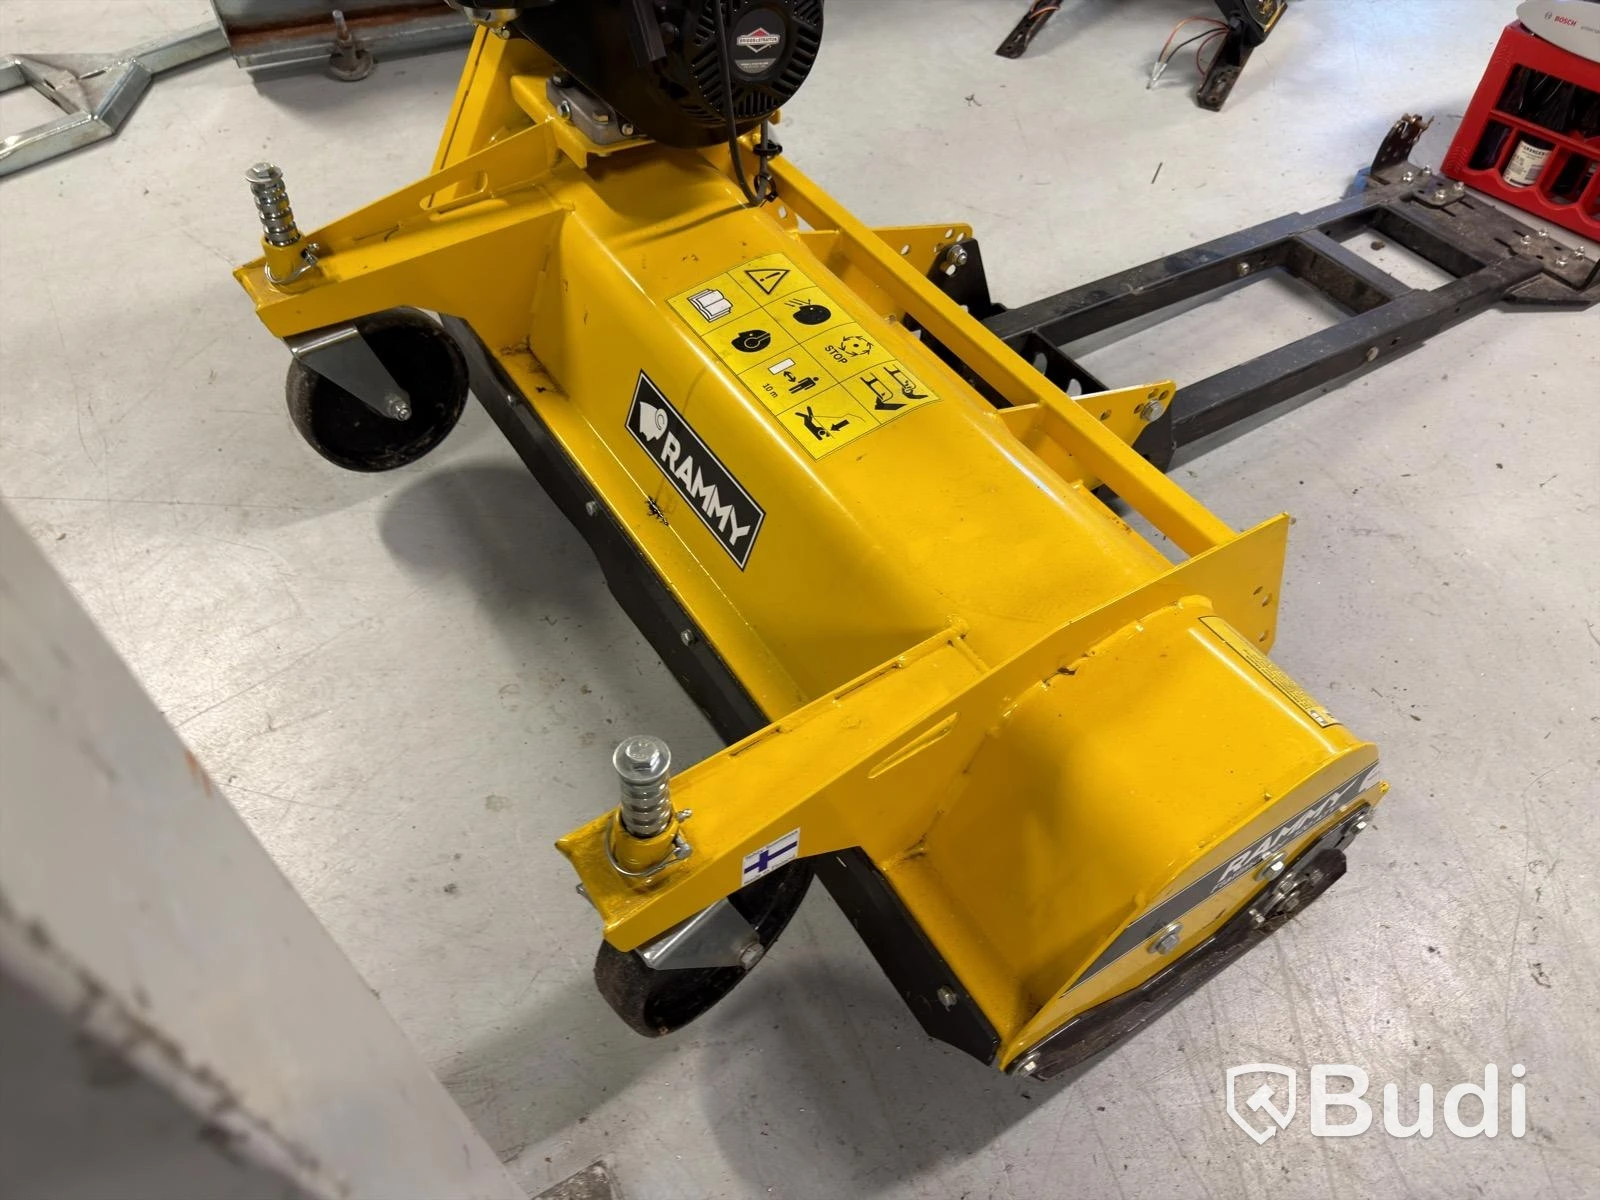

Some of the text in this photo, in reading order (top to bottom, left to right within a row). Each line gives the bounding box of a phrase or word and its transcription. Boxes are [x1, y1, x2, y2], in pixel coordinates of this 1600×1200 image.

[1554, 15, 1577, 26] BOSCH
[824, 345, 848, 364] STOP
[762, 383, 778, 398] 10 m
[661, 430, 751, 546] RAMMY
[1216, 776, 1361, 883] RAMMY
